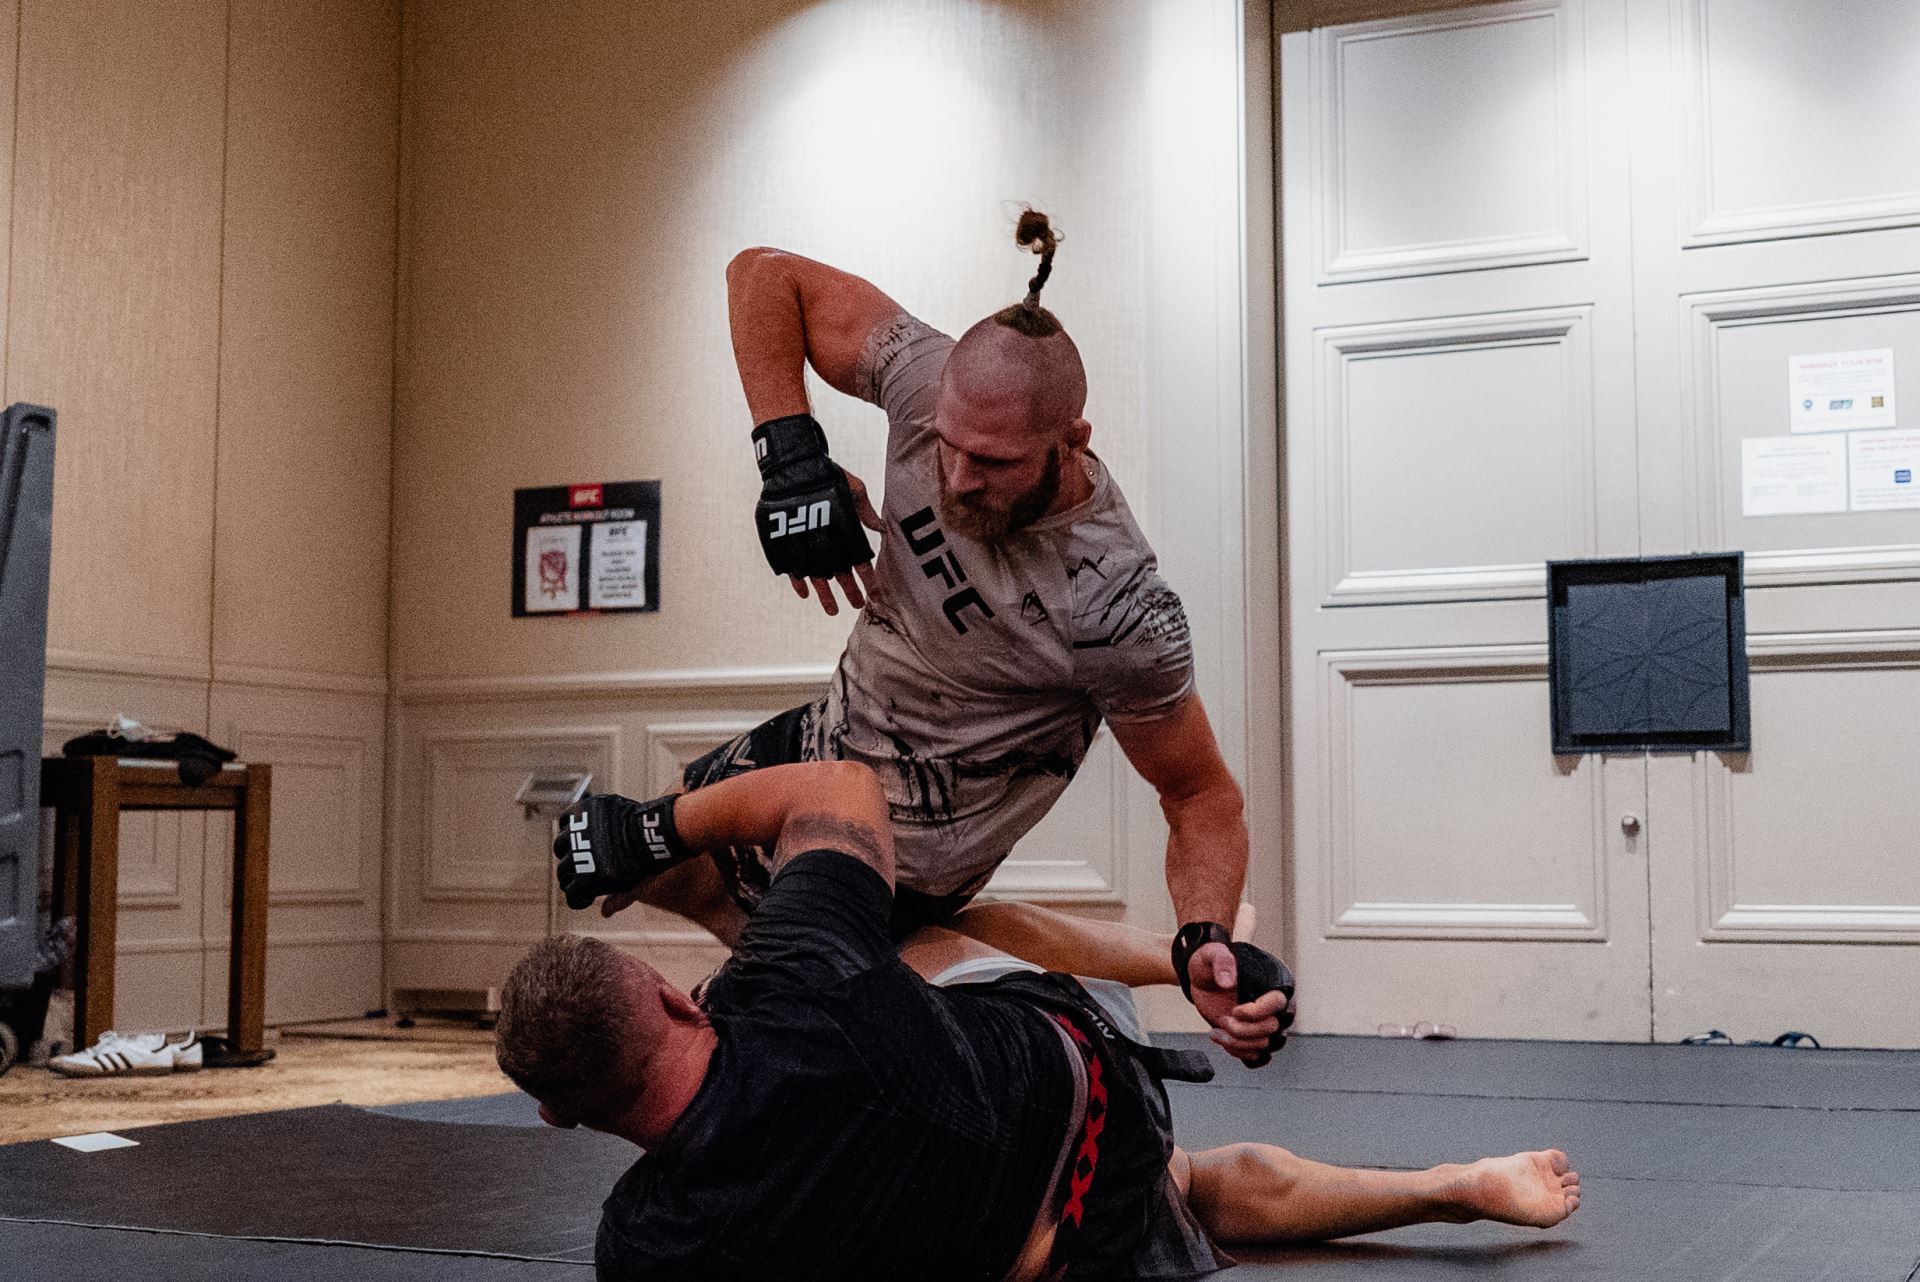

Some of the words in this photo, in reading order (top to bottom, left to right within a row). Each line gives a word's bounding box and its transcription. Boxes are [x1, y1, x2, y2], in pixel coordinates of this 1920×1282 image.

[769, 500, 831, 539] UFC
[900, 506, 996, 635] UFC
[569, 811, 596, 874] UFC
[642, 812, 672, 860] UFC
